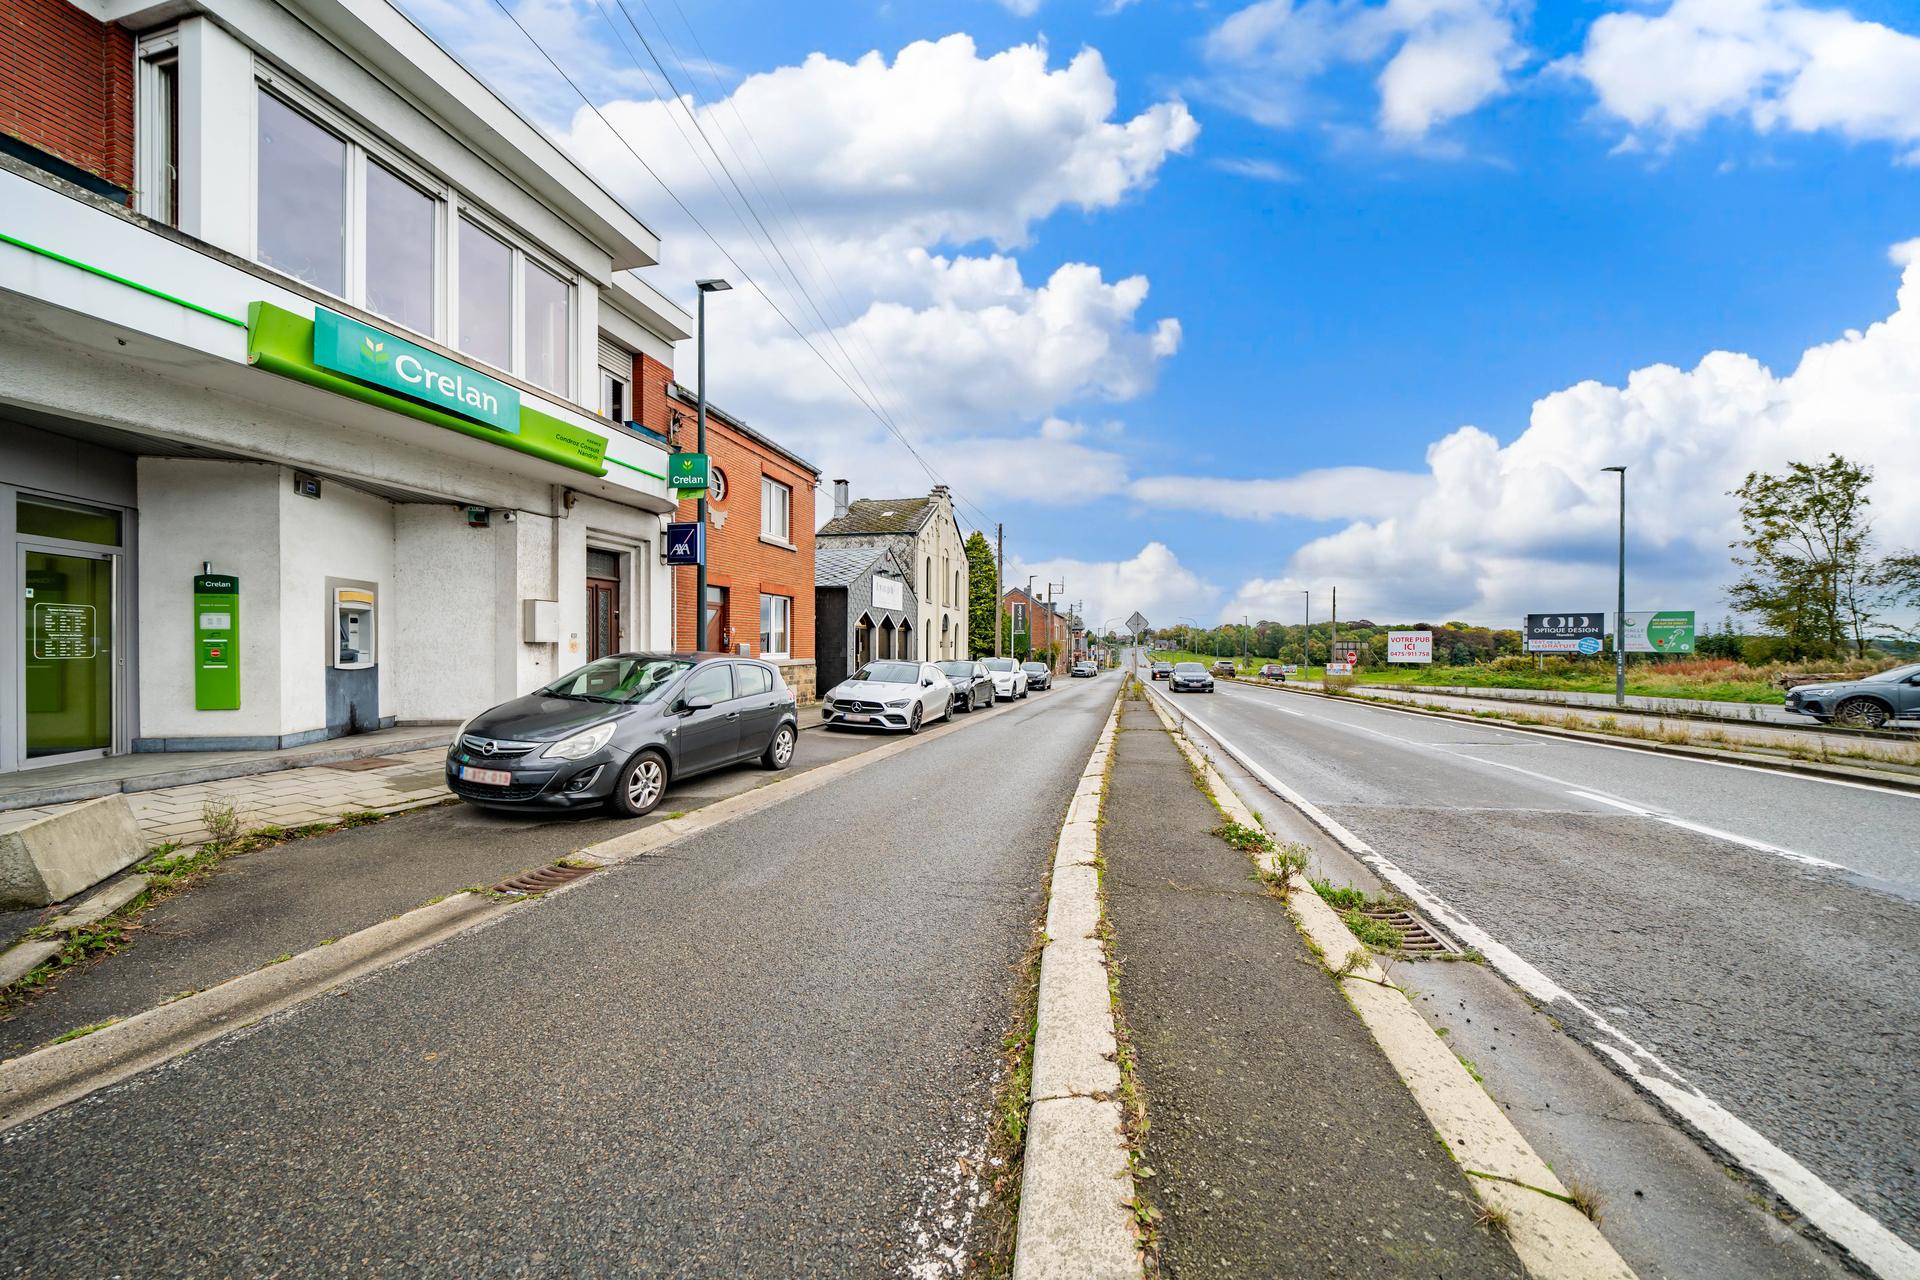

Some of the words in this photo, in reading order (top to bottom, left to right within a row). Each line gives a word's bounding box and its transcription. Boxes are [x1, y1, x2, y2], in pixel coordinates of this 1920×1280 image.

[395, 354, 498, 415] Crelan
[555, 433, 580, 447] Condroz
[580, 442, 600, 455] Consult
[672, 475, 704, 484] Crelan
[669, 543, 691, 556] AXA
[205, 580, 231, 588] Crelan
